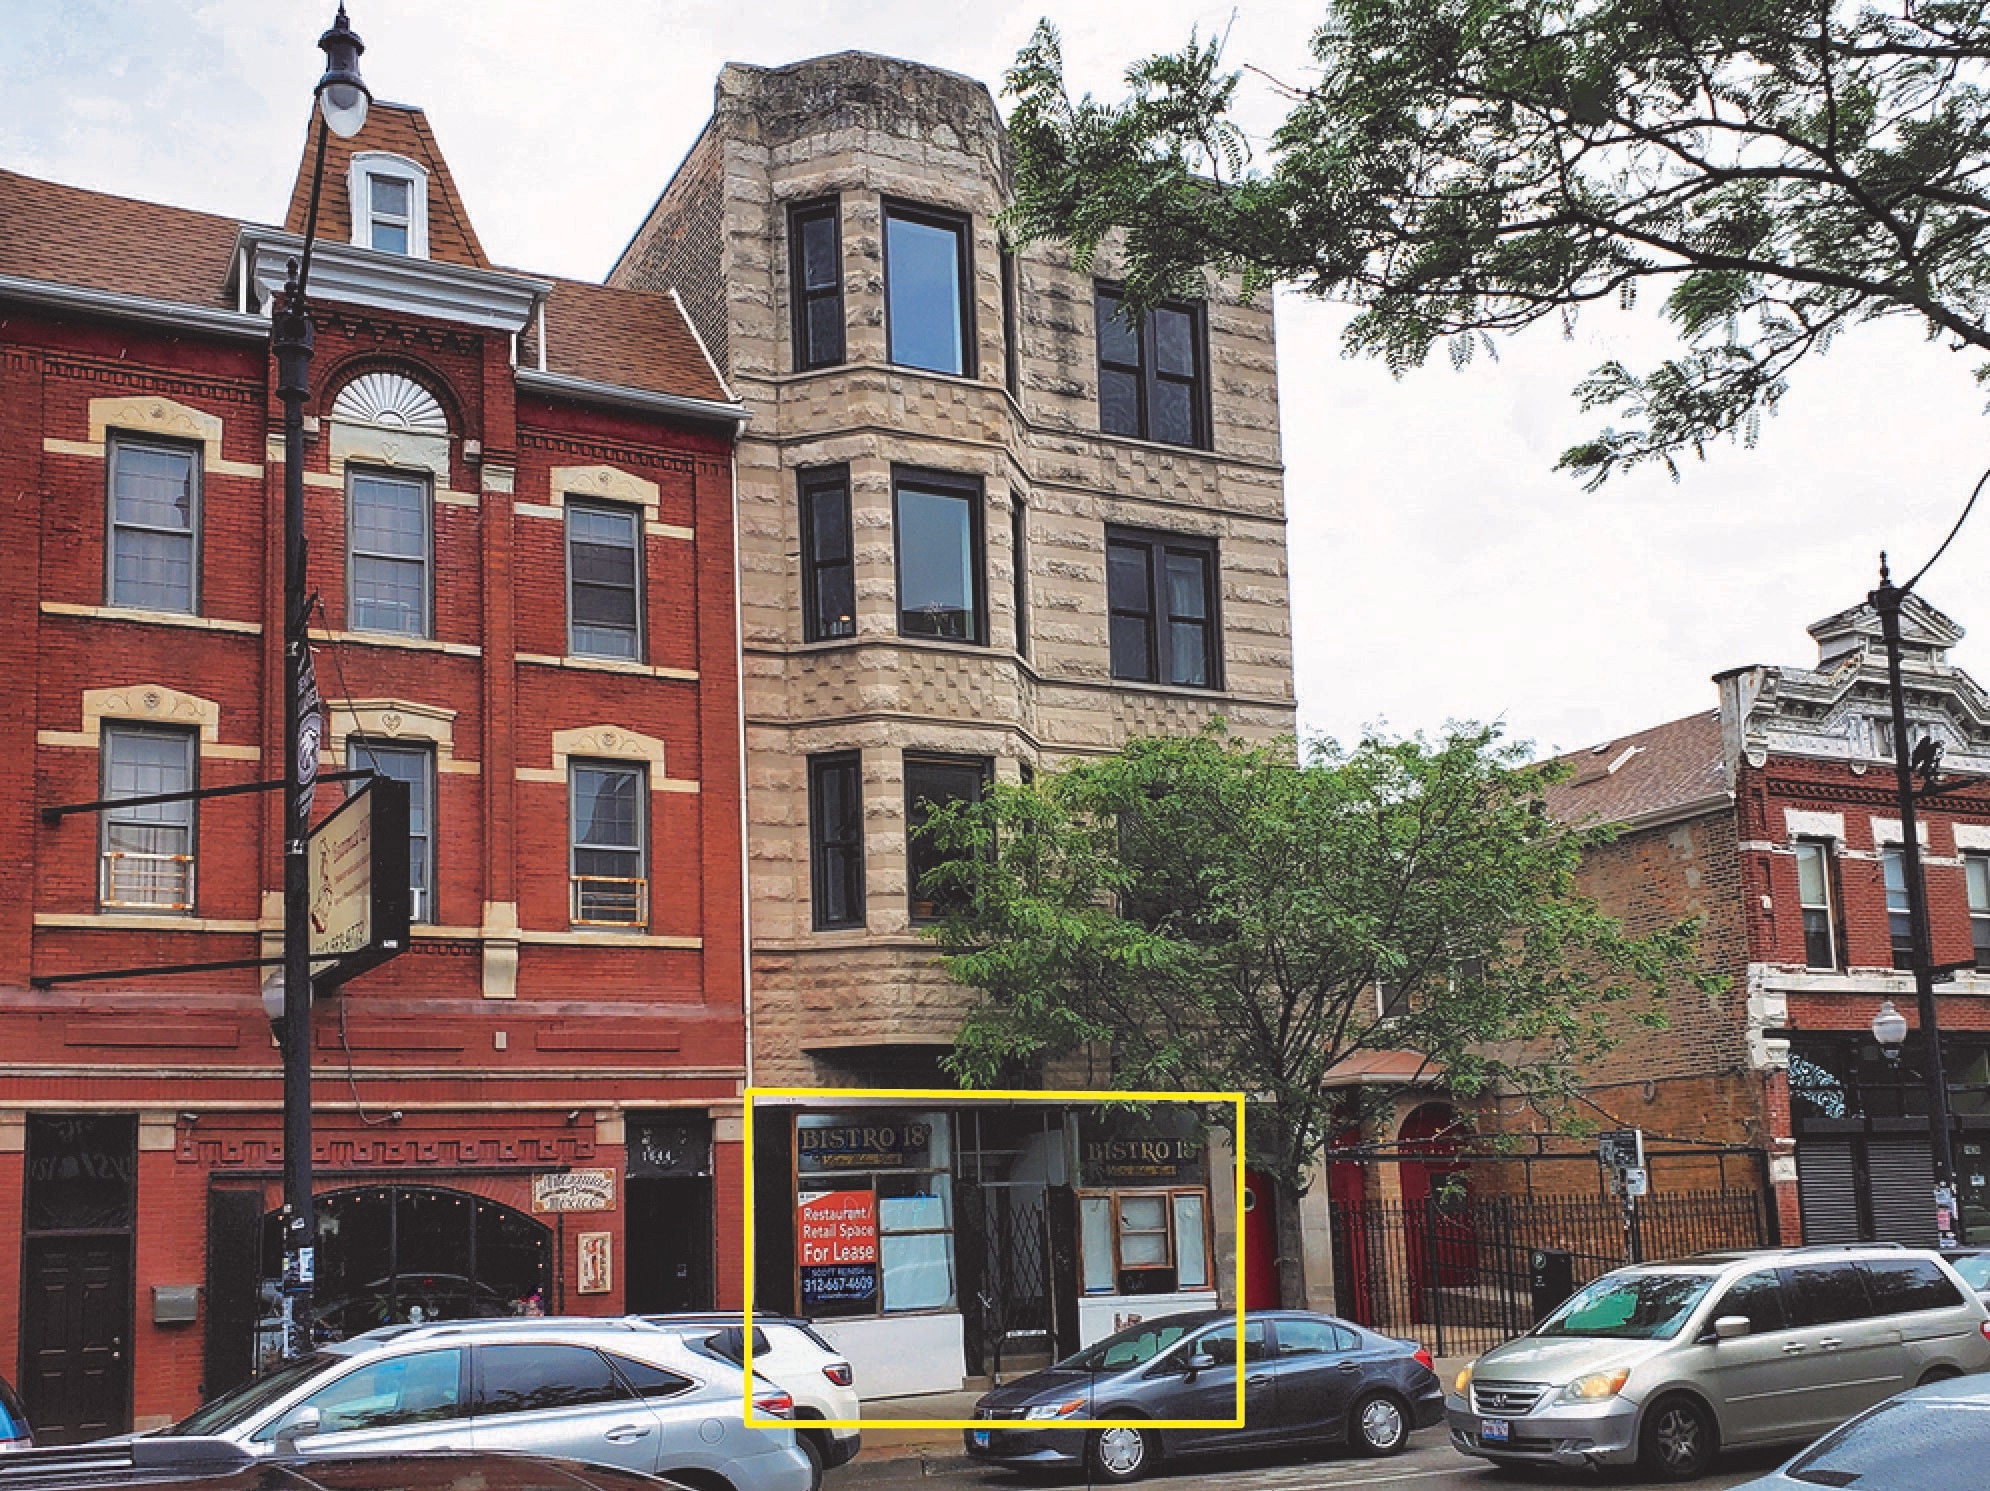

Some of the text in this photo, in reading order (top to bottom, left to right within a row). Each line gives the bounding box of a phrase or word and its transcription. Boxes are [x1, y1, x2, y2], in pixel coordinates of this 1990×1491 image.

[801, 1128, 895, 1152] BISTRO
[1088, 1141, 1169, 1163] BISTRO
[803, 1223, 874, 1240] Retail Space
[803, 1241, 875, 1262] For Lease
